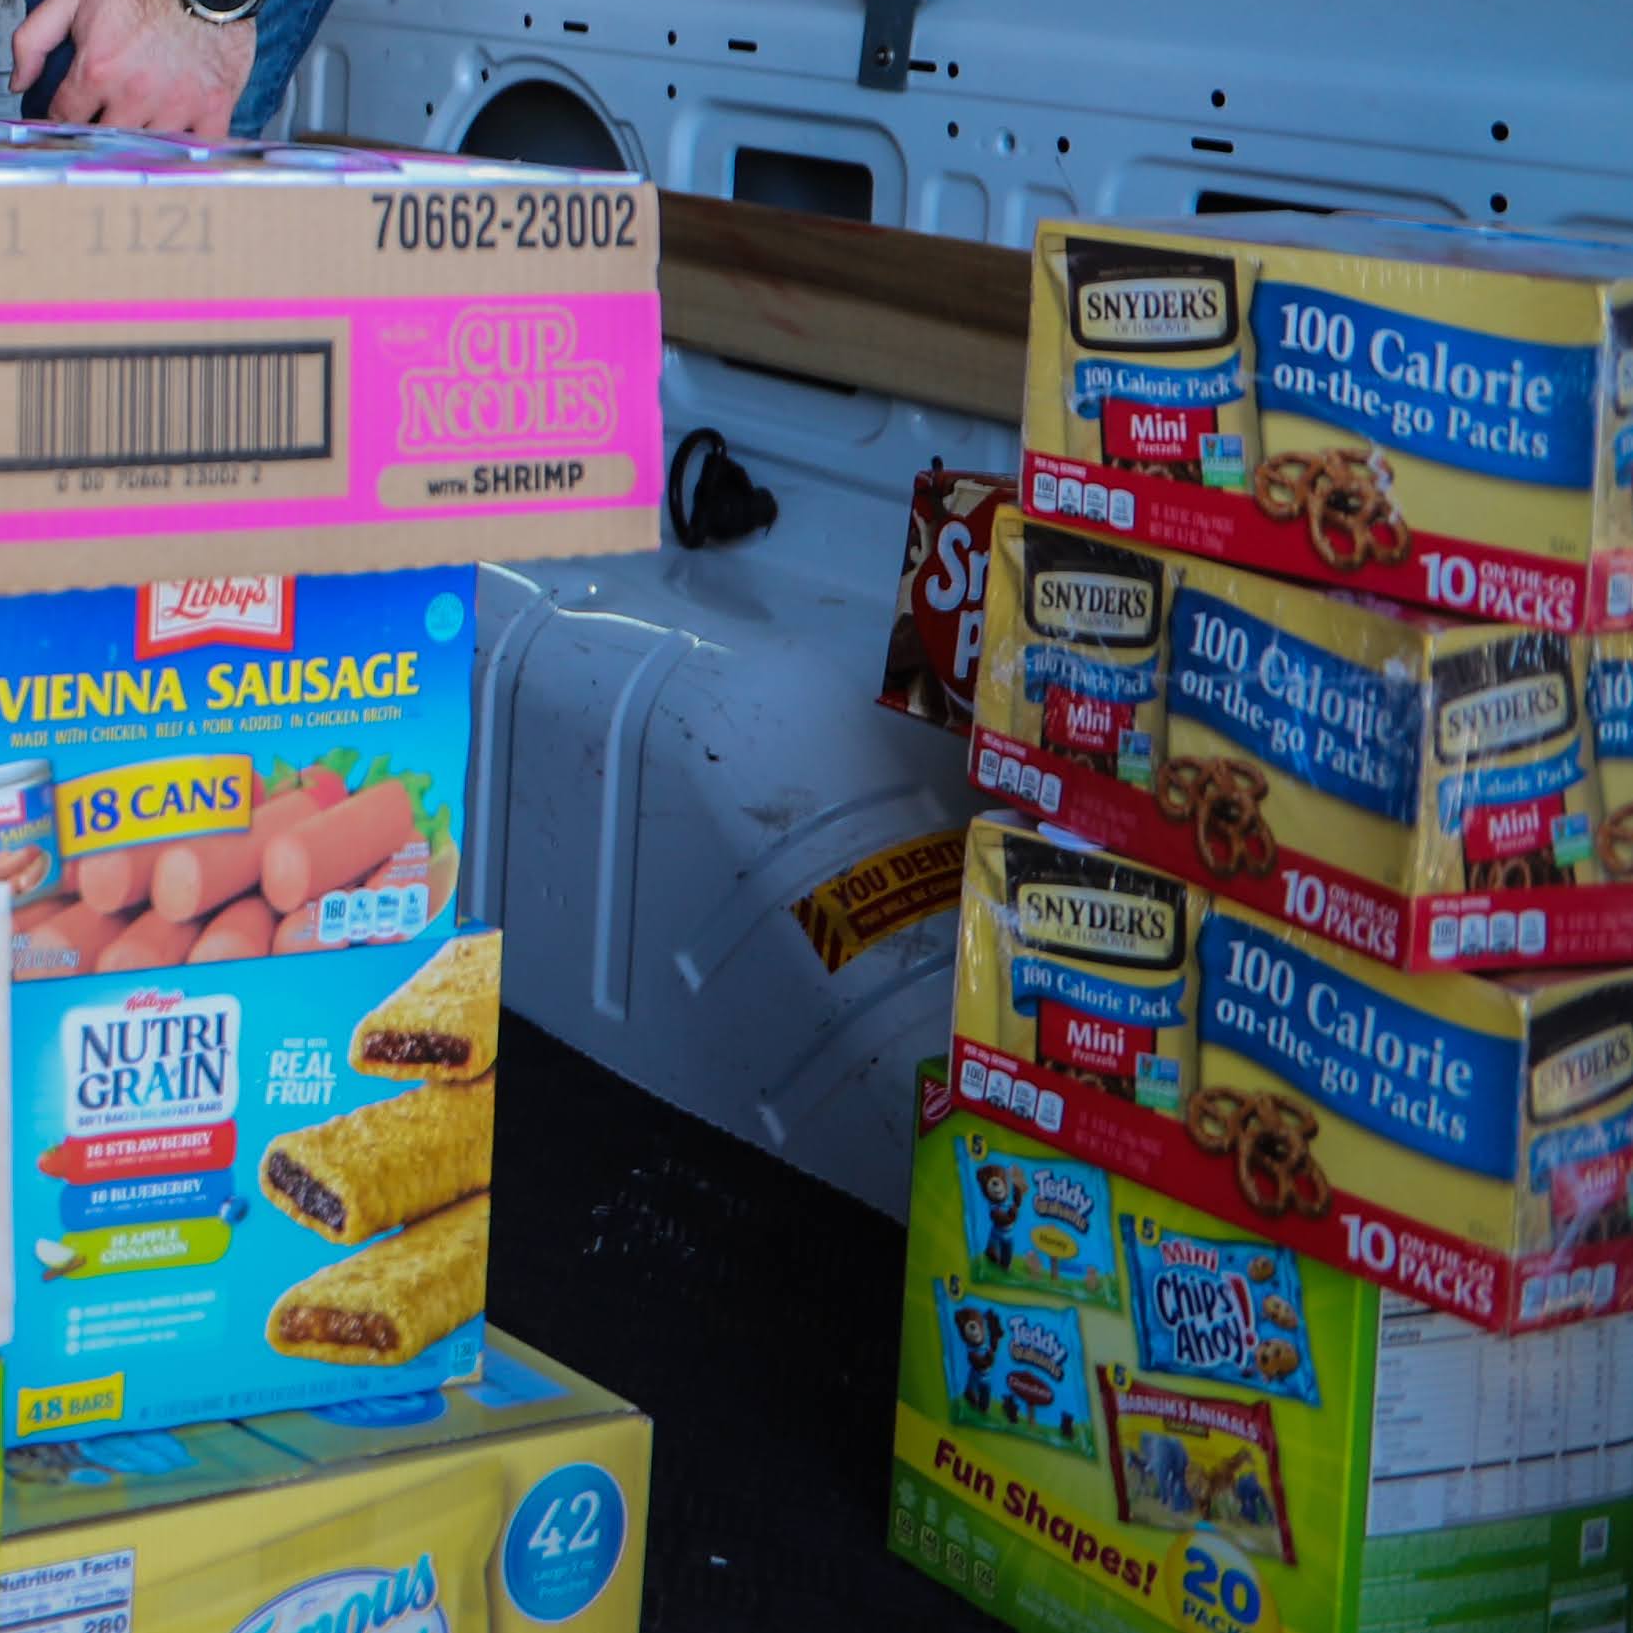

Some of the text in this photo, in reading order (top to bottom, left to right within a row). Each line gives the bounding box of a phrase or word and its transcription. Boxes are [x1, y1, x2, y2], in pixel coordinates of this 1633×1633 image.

[372, 193, 638, 251] 70662-23002
[1087, 285, 1218, 321] SNYDER'S
[1280, 302, 1554, 414] 100 Calorie
[405, 372, 611, 444] NOODLES
[1130, 412, 1187, 442] Mini
[1273, 362, 1550, 459] on-the-go Packs
[428, 461, 586, 496] WITH SHRIMP
[1041, 580, 1147, 620] SNYDER'S
[1420, 551, 1477, 607] 10
[1480, 584, 1574, 631] PACKS
[207, 651, 421, 712] SAUSAGE
[1191, 611, 1396, 744] 100 Calorie
[1067, 702, 1112, 733] Mini
[1181, 669, 1388, 789] on-the-go Packs
[69, 775, 242, 840] 18 CANS
[1489, 804, 1539, 842] Mini
[831, 868, 889, 912] YOU
[1027, 892, 1167, 941] SNYDER'S
[1282, 869, 1326, 924] 10
[1326, 905, 1398, 960] PACKS
[1022, 963, 1172, 1020] 100 Calorie Pack
[80, 1011, 229, 1074] NUTRI
[1067, 1020, 1125, 1056] Mini
[1226, 940, 1474, 1099] 100 Calorie
[77, 1049, 227, 1111] GRAIN
[270, 1050, 336, 1078] REAL
[1216, 996, 1466, 1143] on-the-go Packs
[265, 1080, 336, 1106] FRUIT
[1035, 1168, 1093, 1214] Teddy
[1162, 1239, 1218, 1272] Mini
[1341, 1215, 1395, 1270] 10
[1157, 1272, 1233, 1327] Chips
[1399, 1258, 1493, 1316] PACKS
[27, 1392, 64, 1424] 48
[69, 1391, 115, 1416] BARS
[527, 1489, 602, 1558] 42
[935, 1438, 997, 1504] Fun
[1003, 1481, 1159, 1597] Shapes!
[81, 1553, 134, 1578] Facts
[1182, 1547, 1261, 1625] 20
